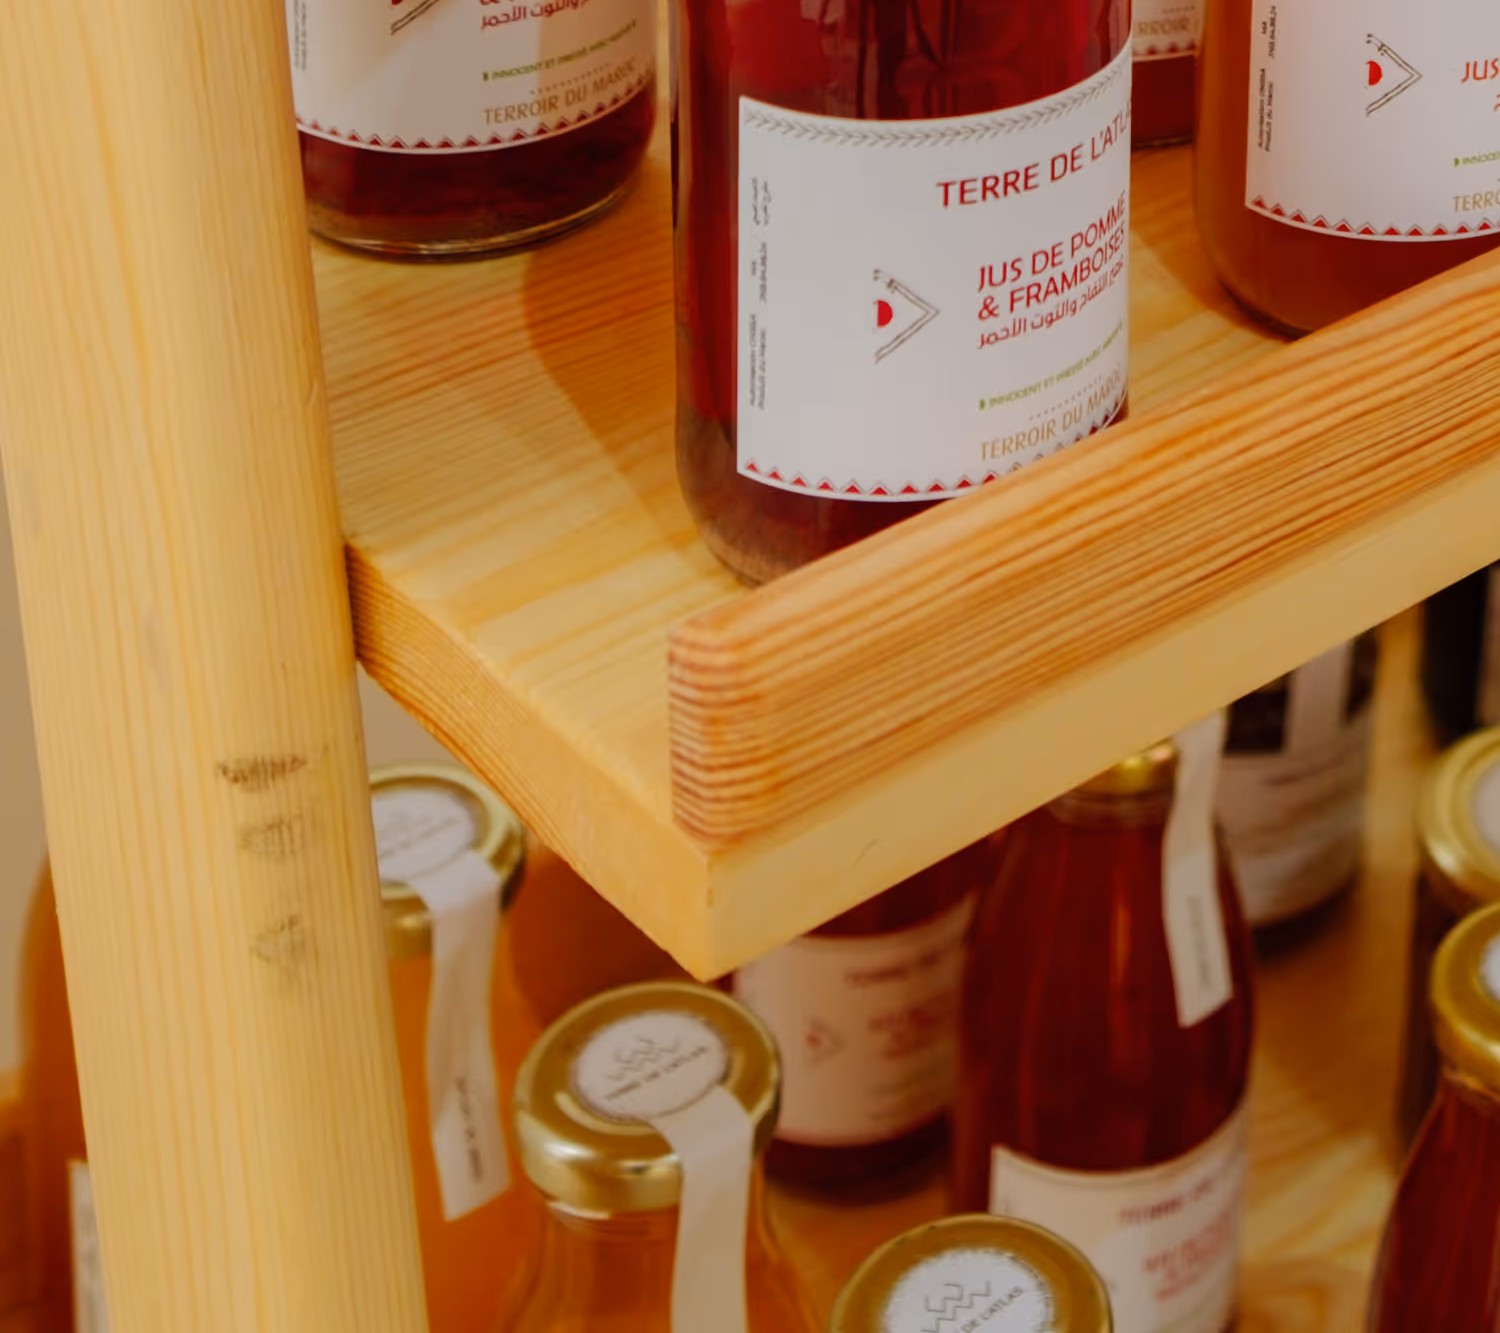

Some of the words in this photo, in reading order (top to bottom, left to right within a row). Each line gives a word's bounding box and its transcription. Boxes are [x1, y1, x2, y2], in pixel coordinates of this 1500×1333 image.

[1460, 57, 1500, 84] JUS
[482, 94, 560, 126] TERROIR
[565, 84, 588, 108] DU
[936, 162, 1040, 210] TERRE
[1049, 143, 1085, 183] DE
[978, 257, 1023, 293] JUS
[1031, 240, 1064, 276] DE
[1071, 189, 1126, 259] POMME
[978, 295, 1000, 321] &
[1009, 219, 1125, 315] FRAMBOISES
[979, 417, 1057, 463] TERROIR
[1062, 403, 1084, 432] DU
[980, 1286, 1026, 1322] L'ATLAS
